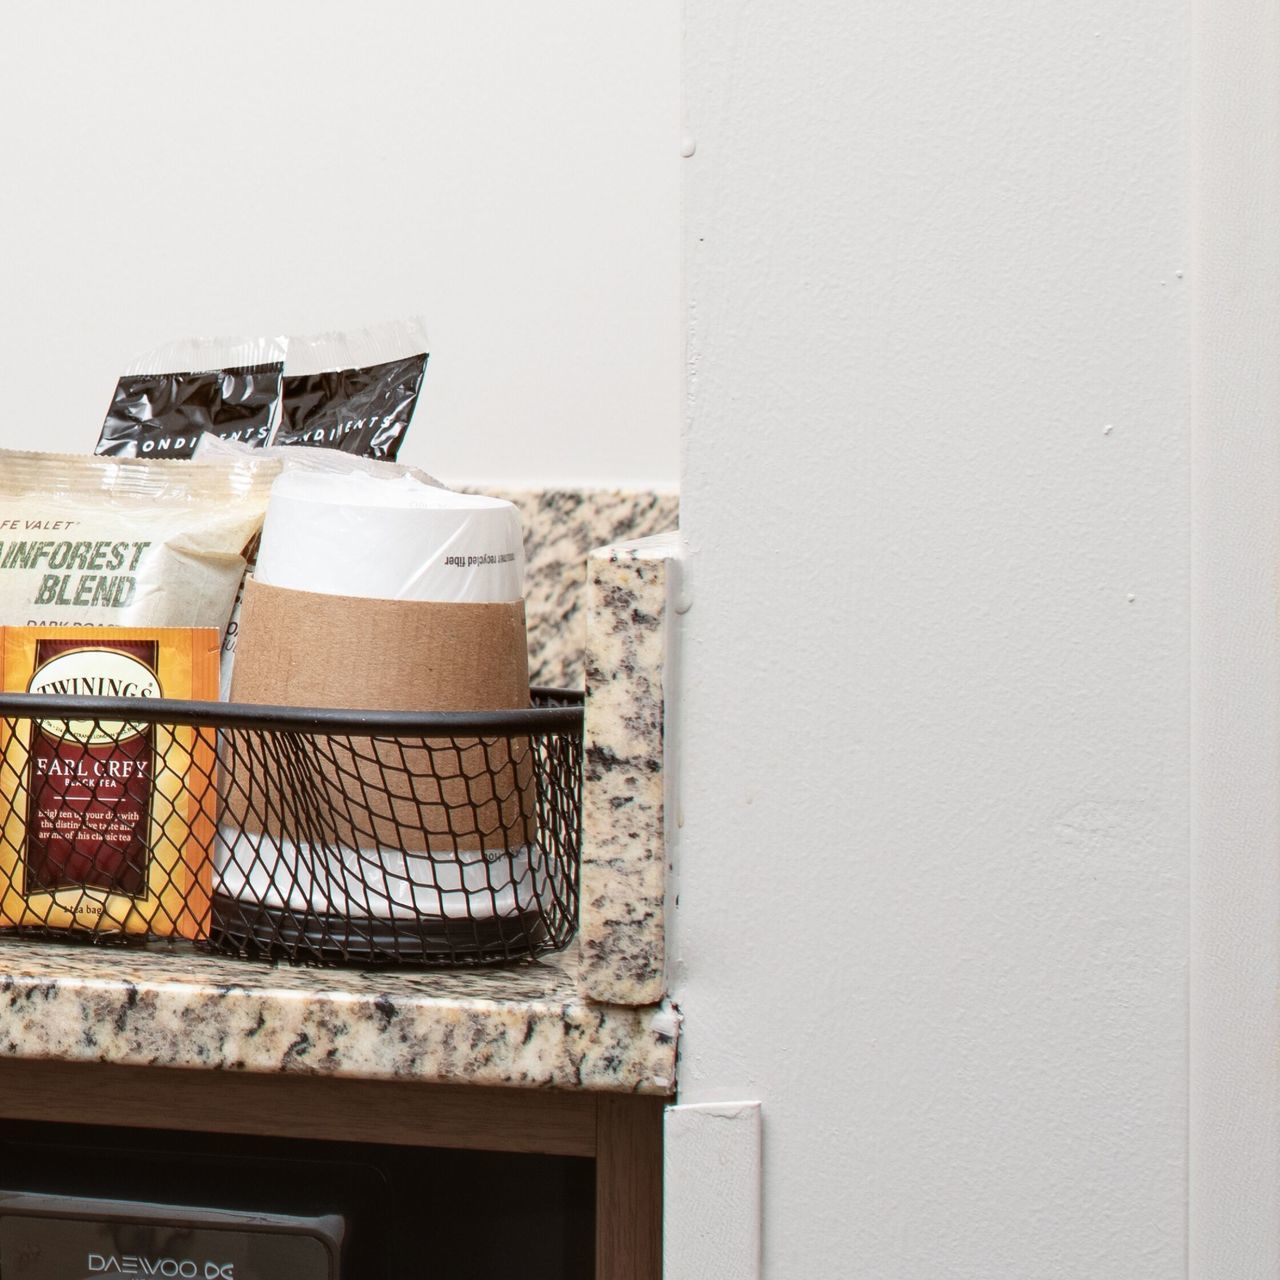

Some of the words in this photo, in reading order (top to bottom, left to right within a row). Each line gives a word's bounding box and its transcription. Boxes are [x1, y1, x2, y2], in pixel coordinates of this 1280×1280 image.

[25, 520, 75, 531] VALET
[444, 556, 466, 567] fiber
[34, 573, 137, 608] BLEND
[121, 811, 139, 820] with
[119, 832, 132, 842] tea
[88, 1253, 197, 1278] DAEWOO
